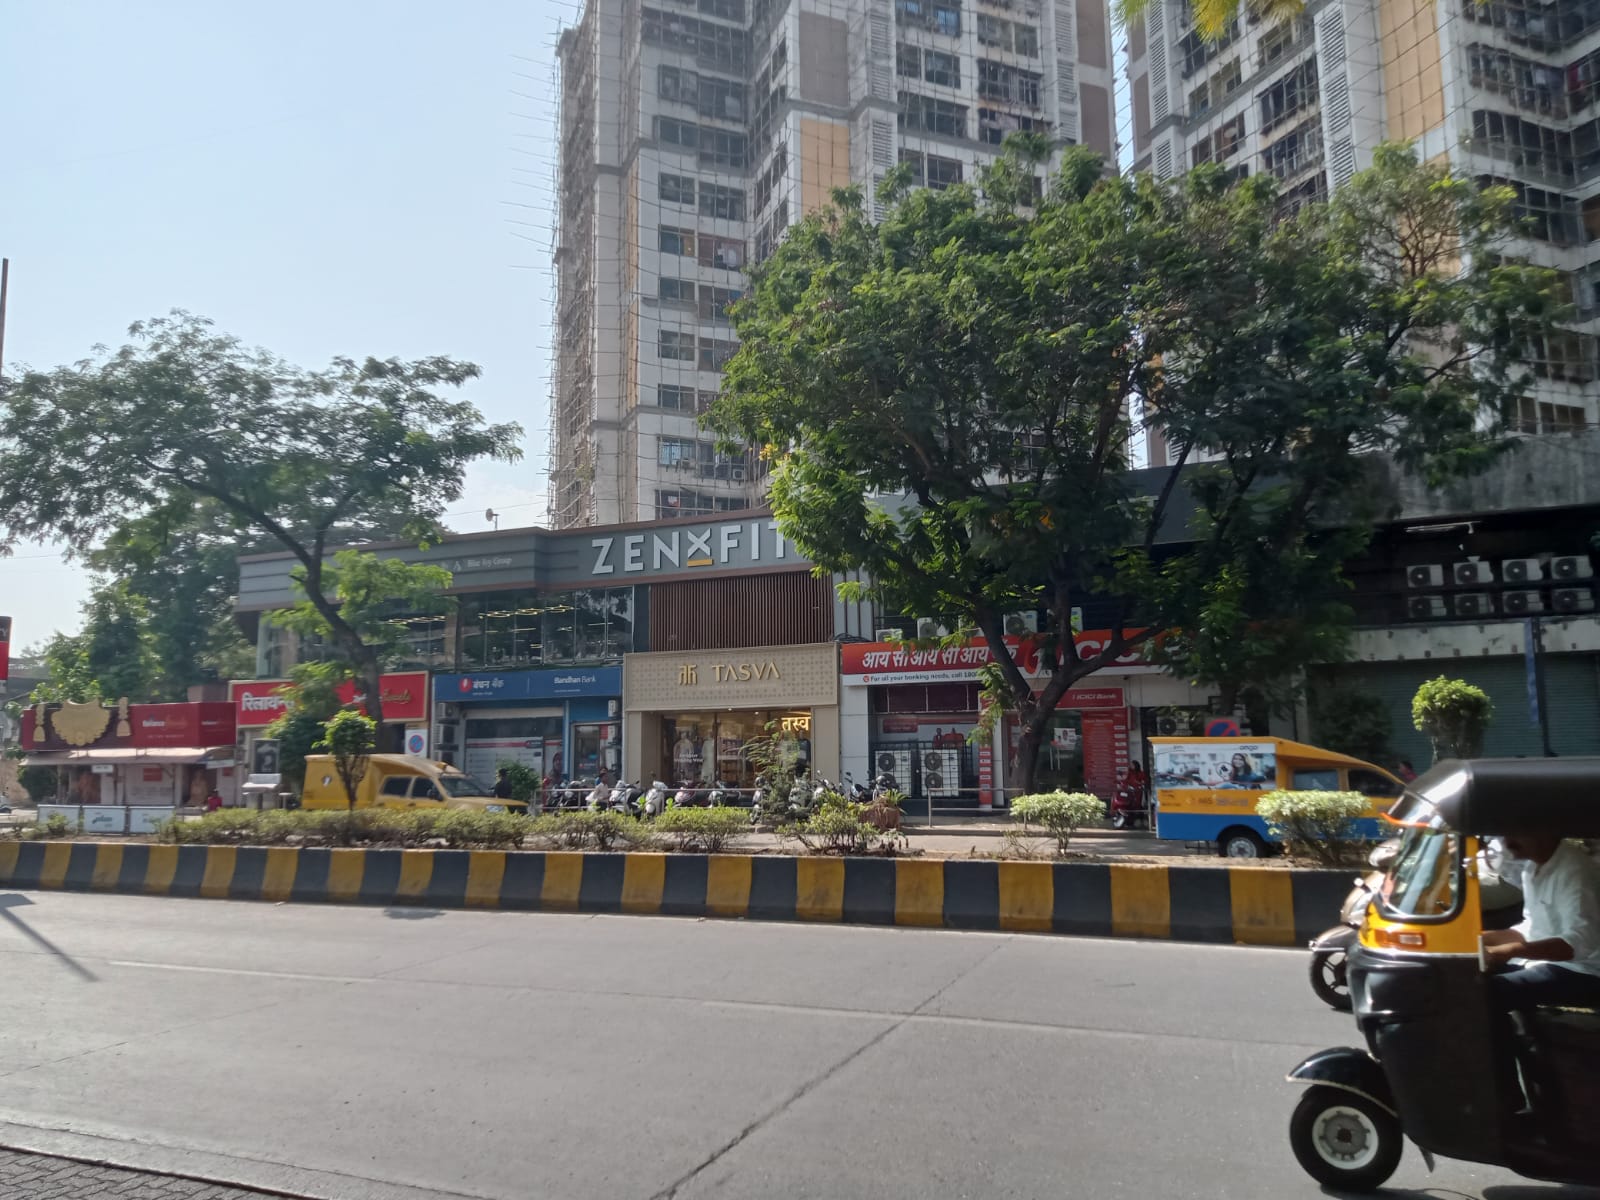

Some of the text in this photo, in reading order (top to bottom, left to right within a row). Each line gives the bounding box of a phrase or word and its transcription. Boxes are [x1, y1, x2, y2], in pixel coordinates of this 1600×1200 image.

[591, 522, 786, 575] ZENXFIT
[862, 651, 892, 669] आय
[959, 646, 990, 664] आय
[554, 675, 596, 684] Bandhan Bank
[711, 662, 781, 682] TASVA
[891, 674, 903, 682] your
[905, 672, 929, 681] banking
[930, 671, 949, 679] needs,
[781, 716, 811, 731] तस्व
